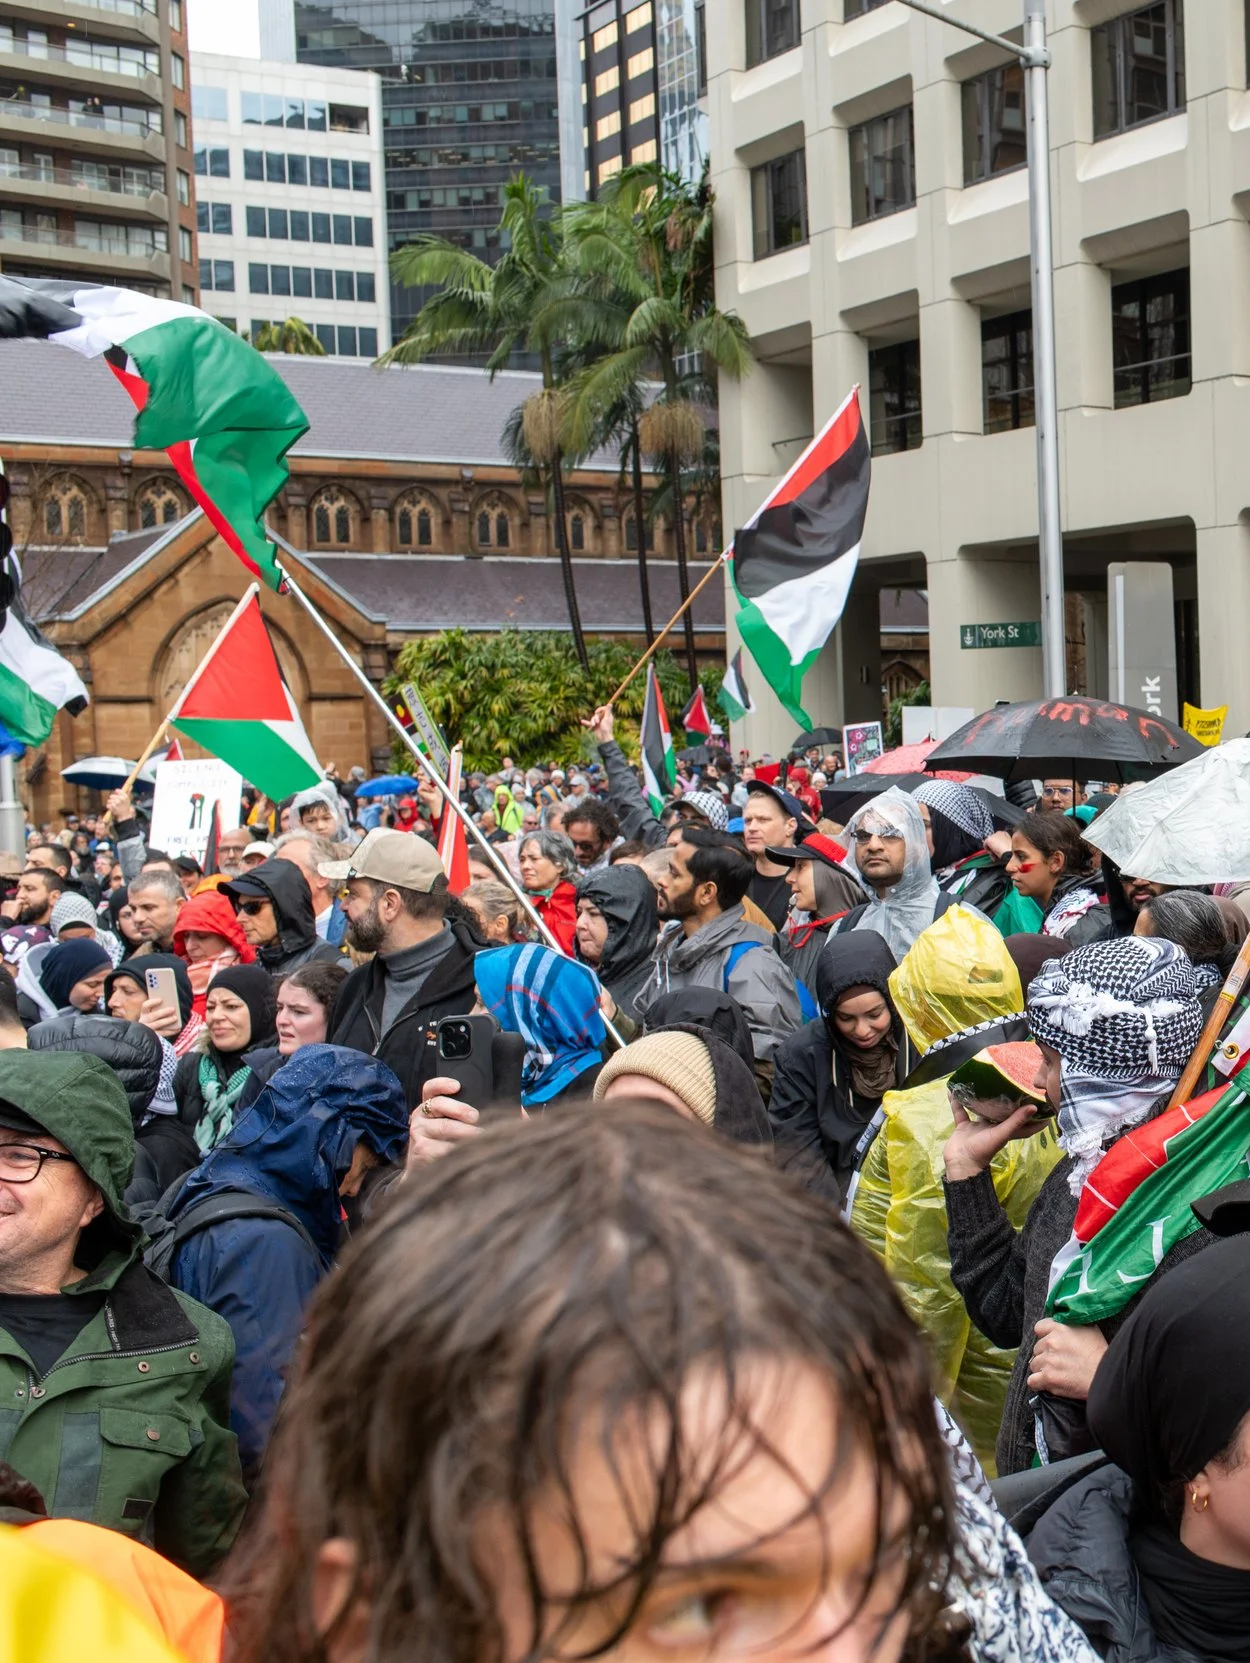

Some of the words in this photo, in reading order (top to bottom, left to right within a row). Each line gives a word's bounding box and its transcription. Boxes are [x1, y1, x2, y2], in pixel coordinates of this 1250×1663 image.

[980, 625, 1006, 640] York
[1007, 625, 1019, 638] St
[1141, 675, 1162, 717] ork
